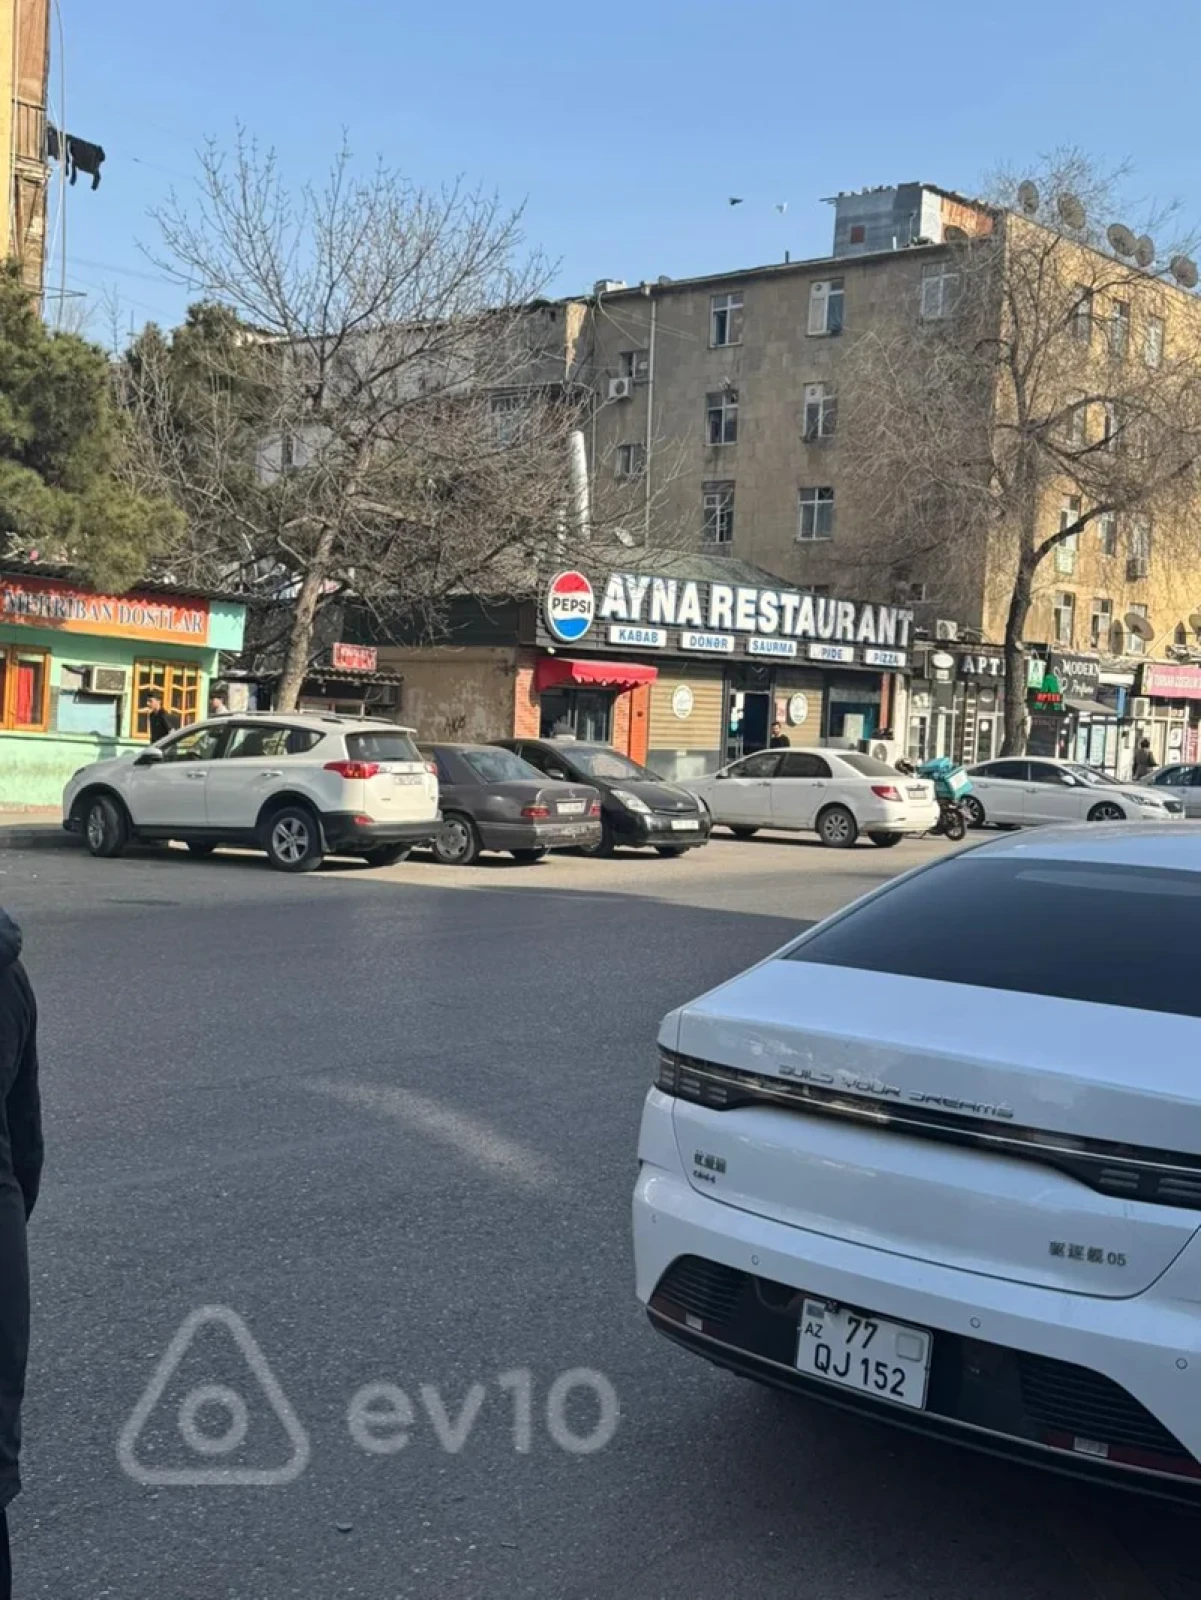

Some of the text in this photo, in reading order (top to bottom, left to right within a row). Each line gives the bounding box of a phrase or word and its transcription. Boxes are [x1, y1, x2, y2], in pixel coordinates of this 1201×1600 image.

[119, 602, 203, 633] DOSTLAR
[552, 597, 591, 614] PEPSI
[599, 572, 914, 647] AYNA RESTAURANT
[619, 629, 659, 643] KABAB
[779, 1064, 1014, 1119] BUILD YOUR DREAMS
[1107, 1251, 1127, 1268] 05
[804, 1321, 824, 1339] AZ
[845, 1315, 879, 1349] 77
[815, 1343, 906, 1397] QJ 152
